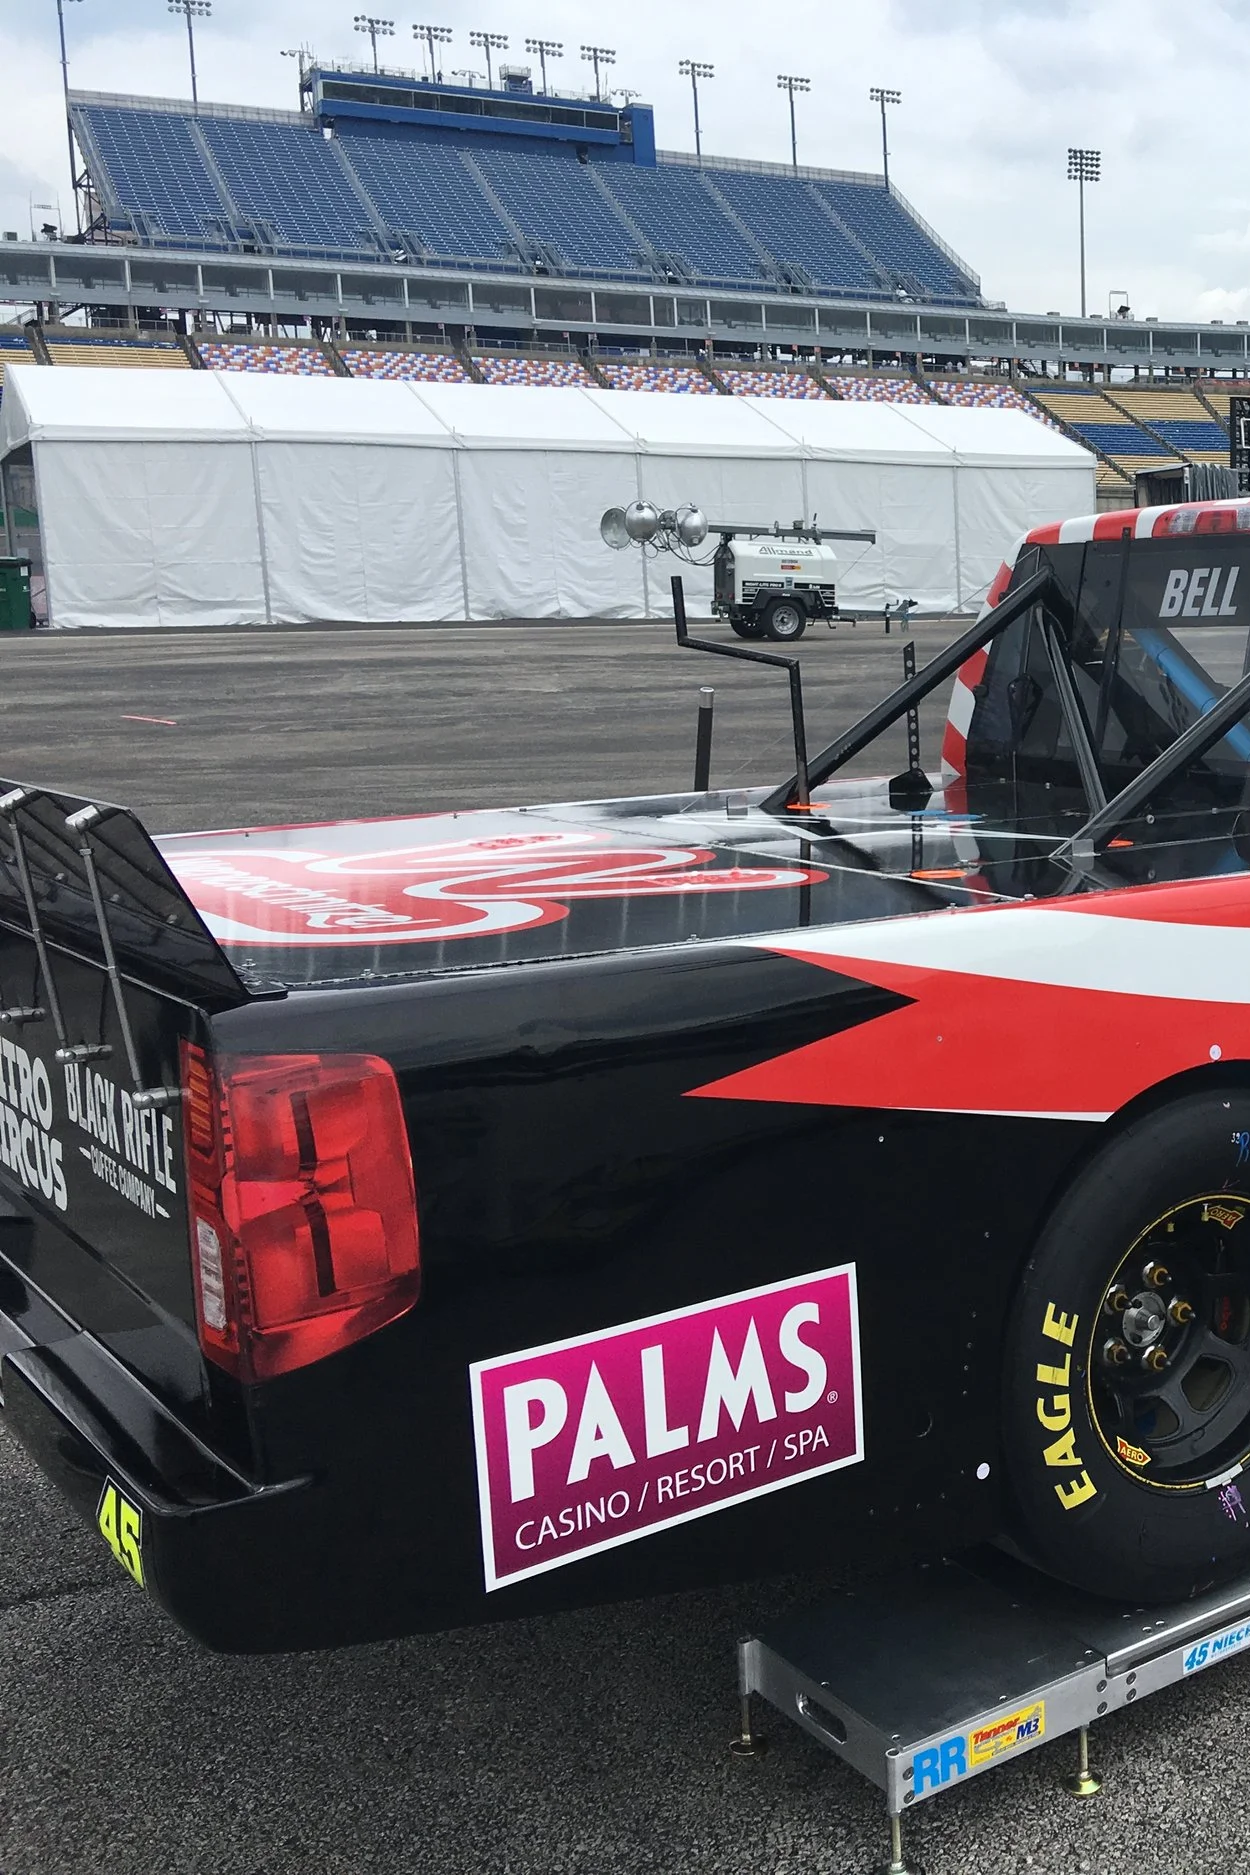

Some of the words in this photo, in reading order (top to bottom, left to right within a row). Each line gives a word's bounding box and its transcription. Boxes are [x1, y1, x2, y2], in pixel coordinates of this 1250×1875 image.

[1158, 566, 1240, 618] BELL
[64, 1063, 121, 1154] BLACK
[121, 1089, 177, 1194] RIFLE
[90, 1145, 119, 1191] COFFEE
[118, 1165, 156, 1219] COMPANY
[503, 1302, 828, 1503] PALMS
[1036, 1302, 1099, 1510] EAGLE
[515, 1490, 631, 1551] CASINO
[657, 1445, 761, 1504] RESORT
[783, 1425, 830, 1462] SPA
[1120, 1446, 1144, 1462] AERO
[98, 1485, 145, 1589] 45
[1185, 1640, 1211, 1671] 45
[914, 1735, 968, 1795] RR
[1016, 1718, 1040, 1740] M3
